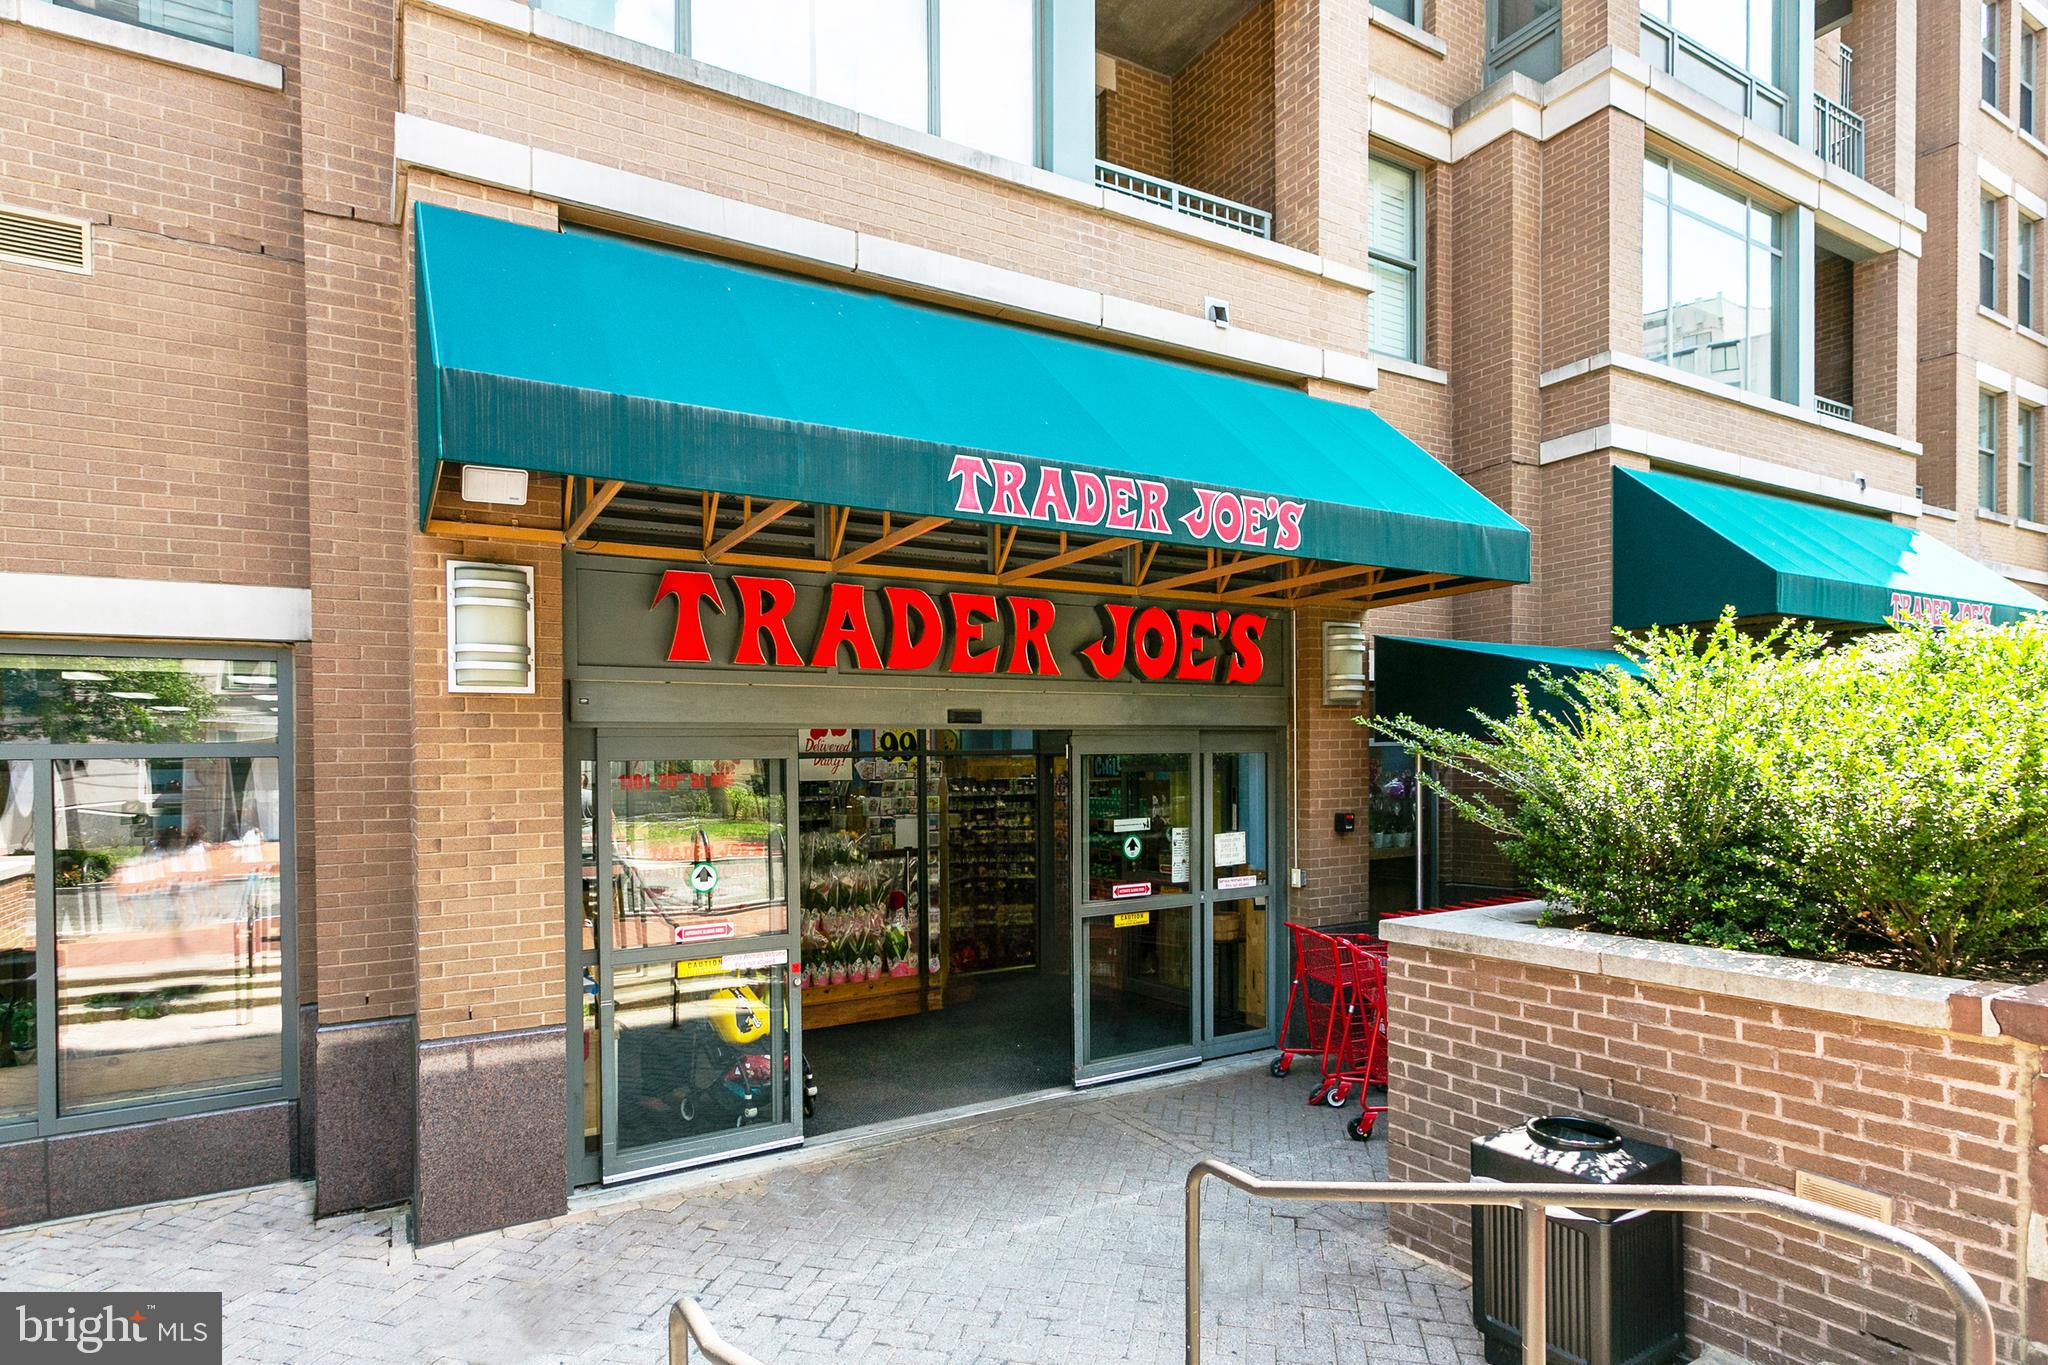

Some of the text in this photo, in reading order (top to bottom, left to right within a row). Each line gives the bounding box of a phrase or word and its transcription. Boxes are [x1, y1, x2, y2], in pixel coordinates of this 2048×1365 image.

[948, 454, 1306, 551] TRADER JOE'S
[650, 570, 1268, 684] TRADER JOE'S
[805, 738, 851, 752] Delivered
[1120, 912, 1144, 921] CAUTION
[687, 959, 722, 969] CAUTION
